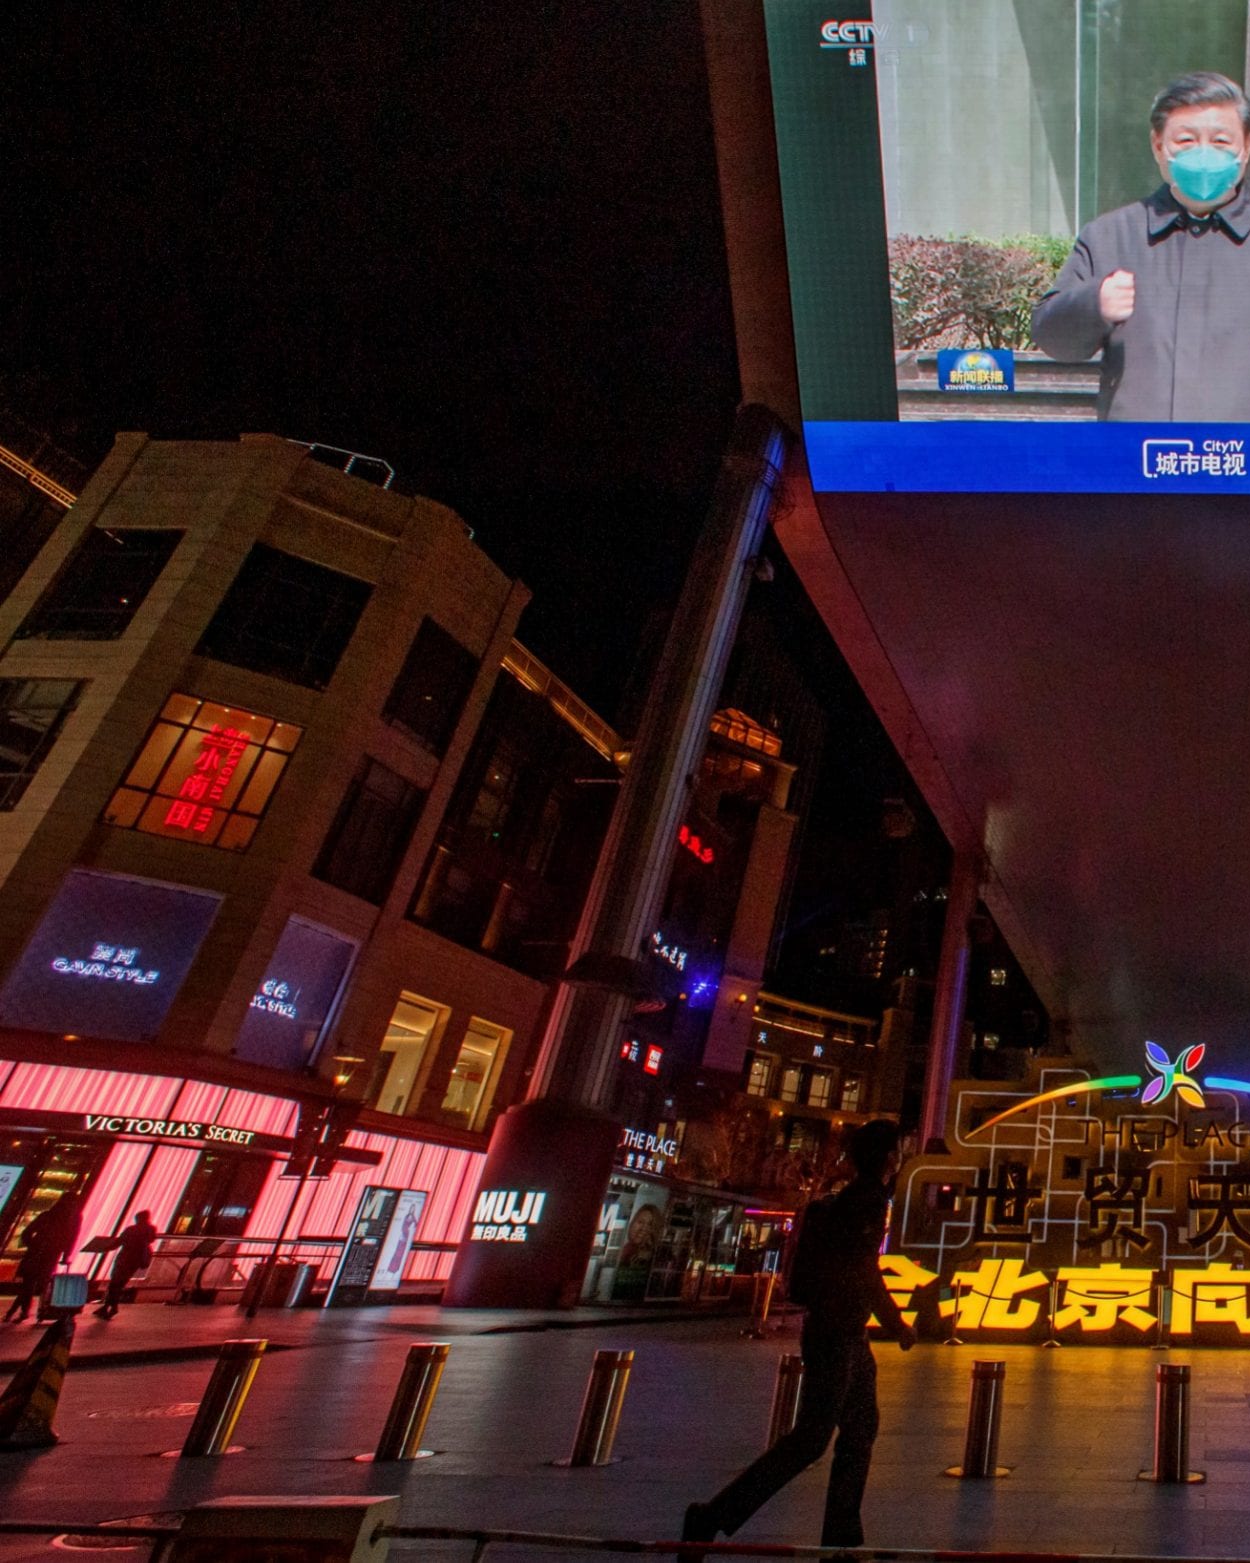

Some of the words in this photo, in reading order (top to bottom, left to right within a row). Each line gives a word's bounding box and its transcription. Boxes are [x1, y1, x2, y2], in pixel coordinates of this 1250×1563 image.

[1202, 440, 1244, 454] CityTV
[1155, 452, 1247, 476] 城市电视
[84, 1114, 202, 1137] VICTORIA'S
[204, 1124, 255, 1146] SECRET
[623, 1127, 646, 1150] THE
[645, 1134, 677, 1157] PLACE
[1077, 1118, 1147, 1148] THE
[472, 1190, 547, 1224] MUJI
[470, 1224, 527, 1243] 無印良品
